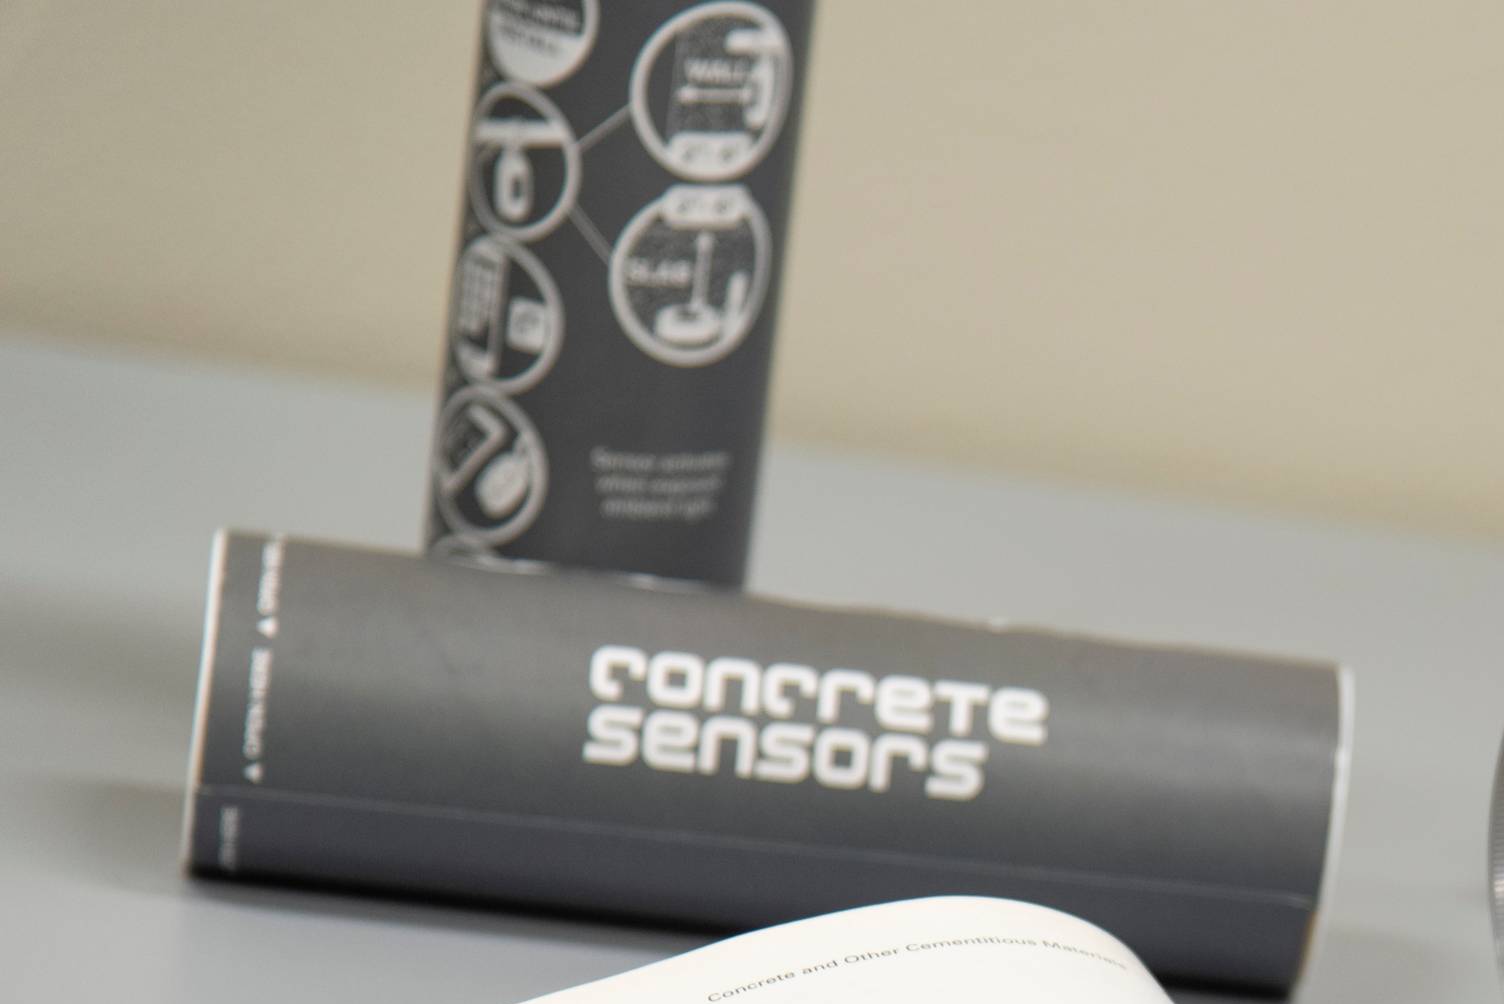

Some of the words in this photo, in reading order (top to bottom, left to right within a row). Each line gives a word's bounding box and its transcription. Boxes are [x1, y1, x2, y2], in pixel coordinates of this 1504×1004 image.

[707, 968, 796, 1003] Concrete
[802, 959, 839, 976] and
[843, 946, 899, 965] Other
[905, 935, 1038, 953] Cementitious
[1043, 939, 1128, 970] Materials
